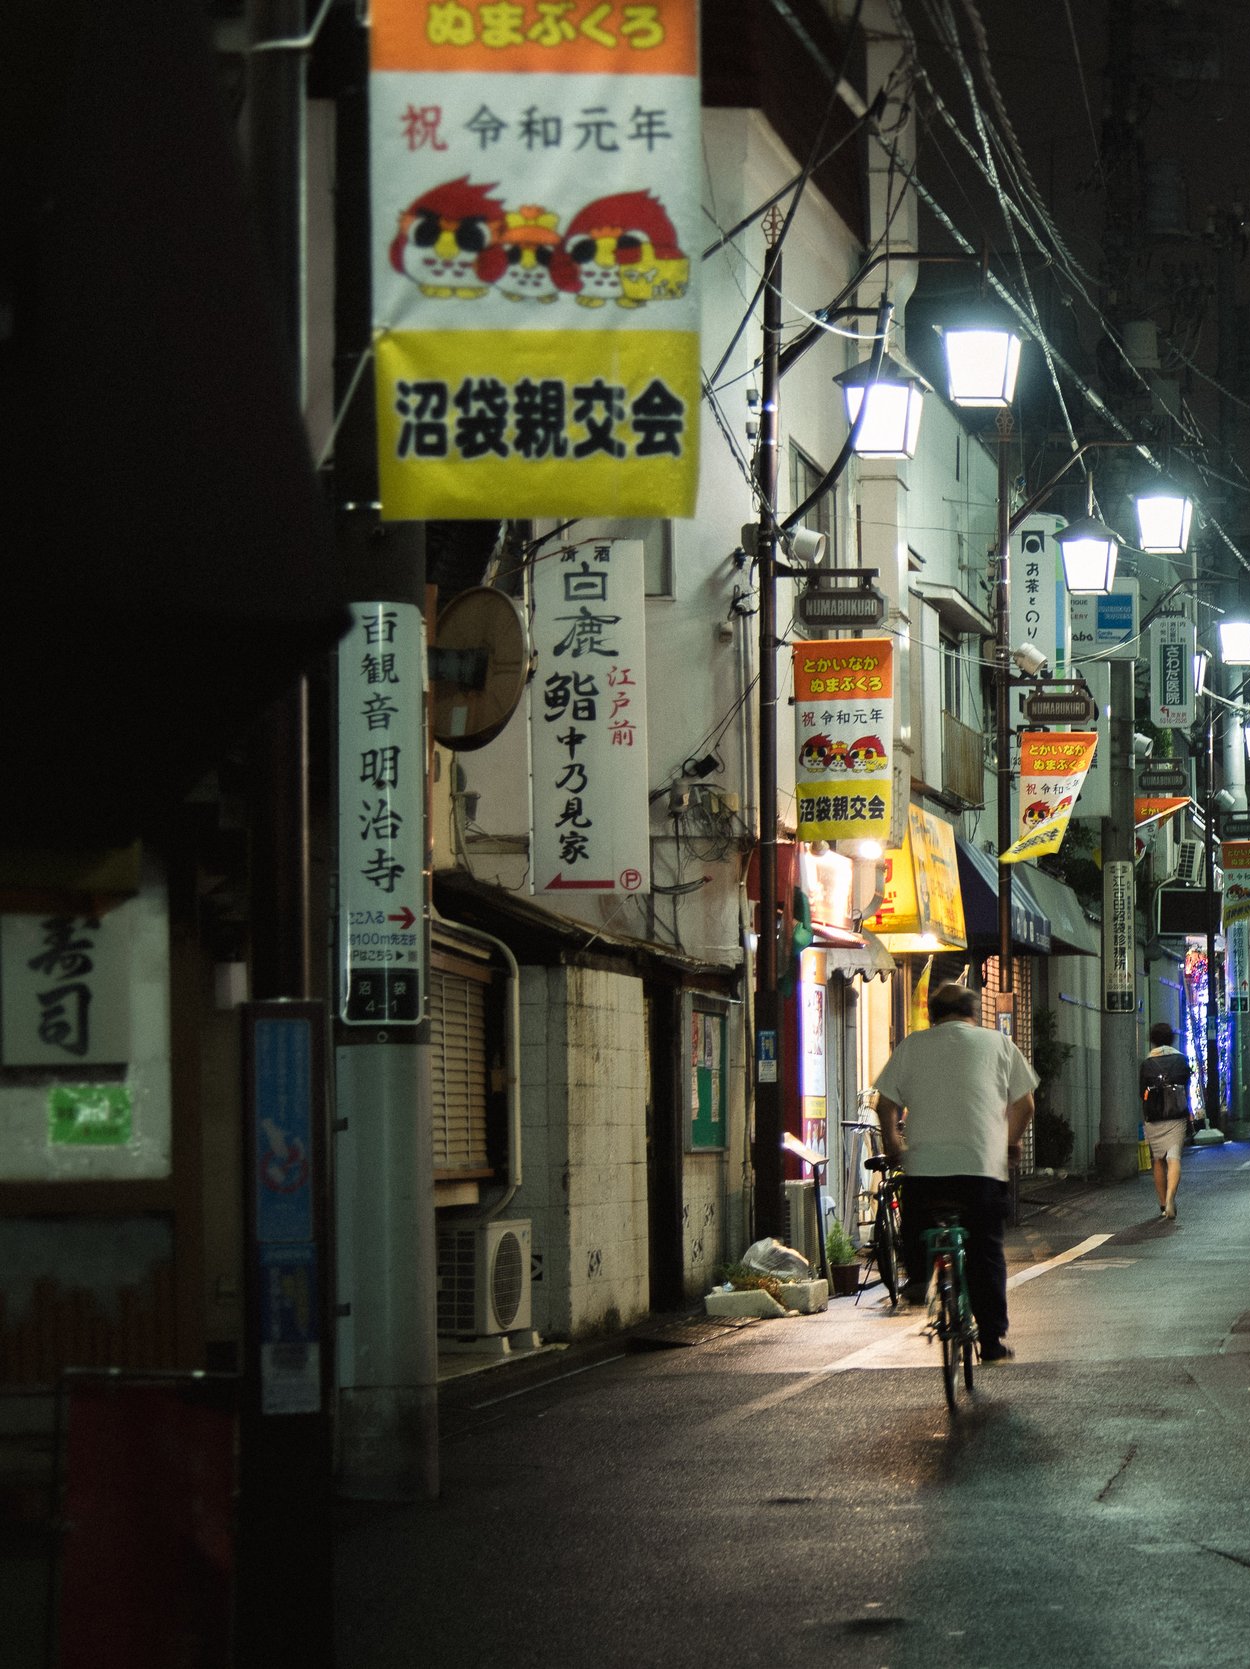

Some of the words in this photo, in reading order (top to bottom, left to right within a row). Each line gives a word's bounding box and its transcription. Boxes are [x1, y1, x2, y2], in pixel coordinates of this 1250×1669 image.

[426, 1, 665, 49] ぬまぶくろ
[400, 104, 448, 152] 祝
[464, 103, 673, 152] 令和元年
[395, 377, 685, 459] 沼袋親交会
[553, 560, 622, 658] 白鹿
[806, 599, 878, 616] NUMABUKURO
[1025, 562, 1040, 639] お茶とのり
[803, 656, 879, 673] とかいなか
[810, 675, 883, 693] ぬまぶくろ
[607, 665, 636, 747] 江戸前
[802, 711, 816, 727] 祝
[820, 708, 884, 725] 令和元年
[1031, 701, 1086, 715] NUMABUKURO
[1029, 744, 1087, 756] とかいなか
[800, 795, 885, 822] 沼袋親交会
